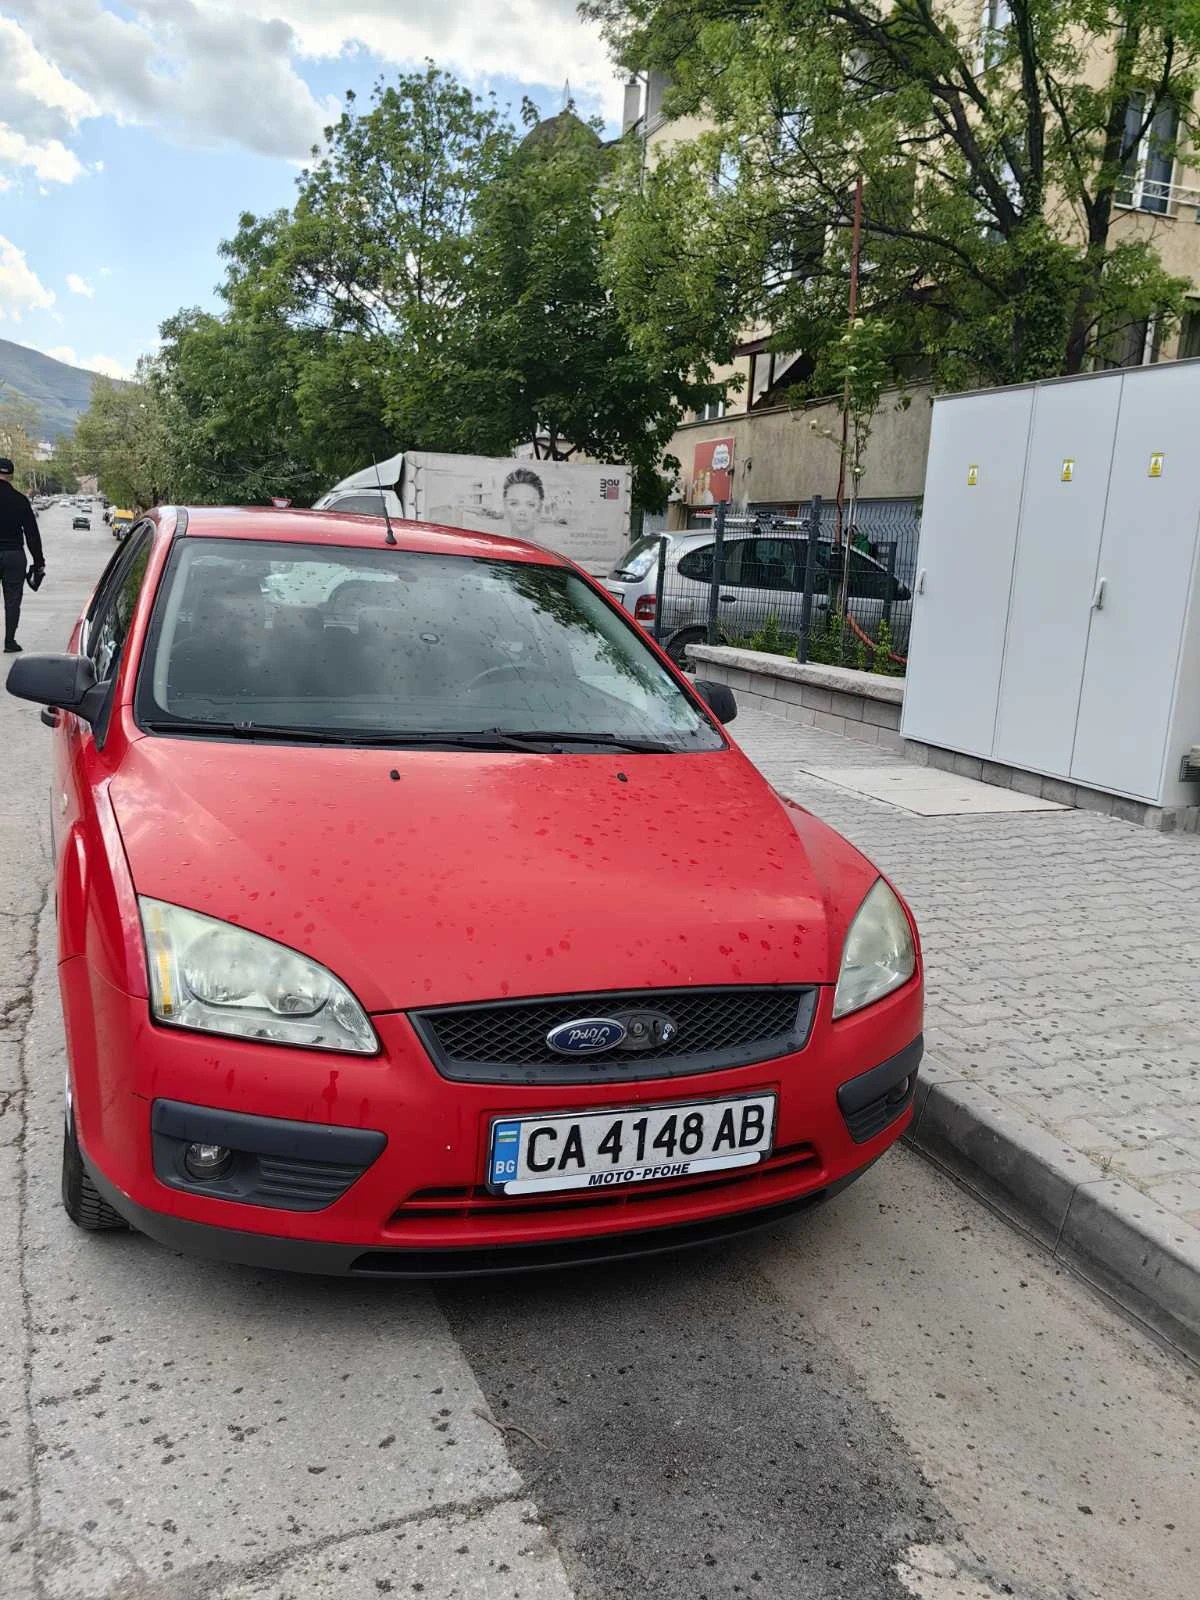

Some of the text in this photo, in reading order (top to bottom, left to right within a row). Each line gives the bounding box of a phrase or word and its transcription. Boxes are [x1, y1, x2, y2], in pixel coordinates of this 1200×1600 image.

[568, 1026, 610, 1048] Ford
[526, 1104, 765, 1172] CA 4148 AB
[495, 1160, 515, 1174] BG
[588, 1163, 691, 1186] MOTO-PFOHE
